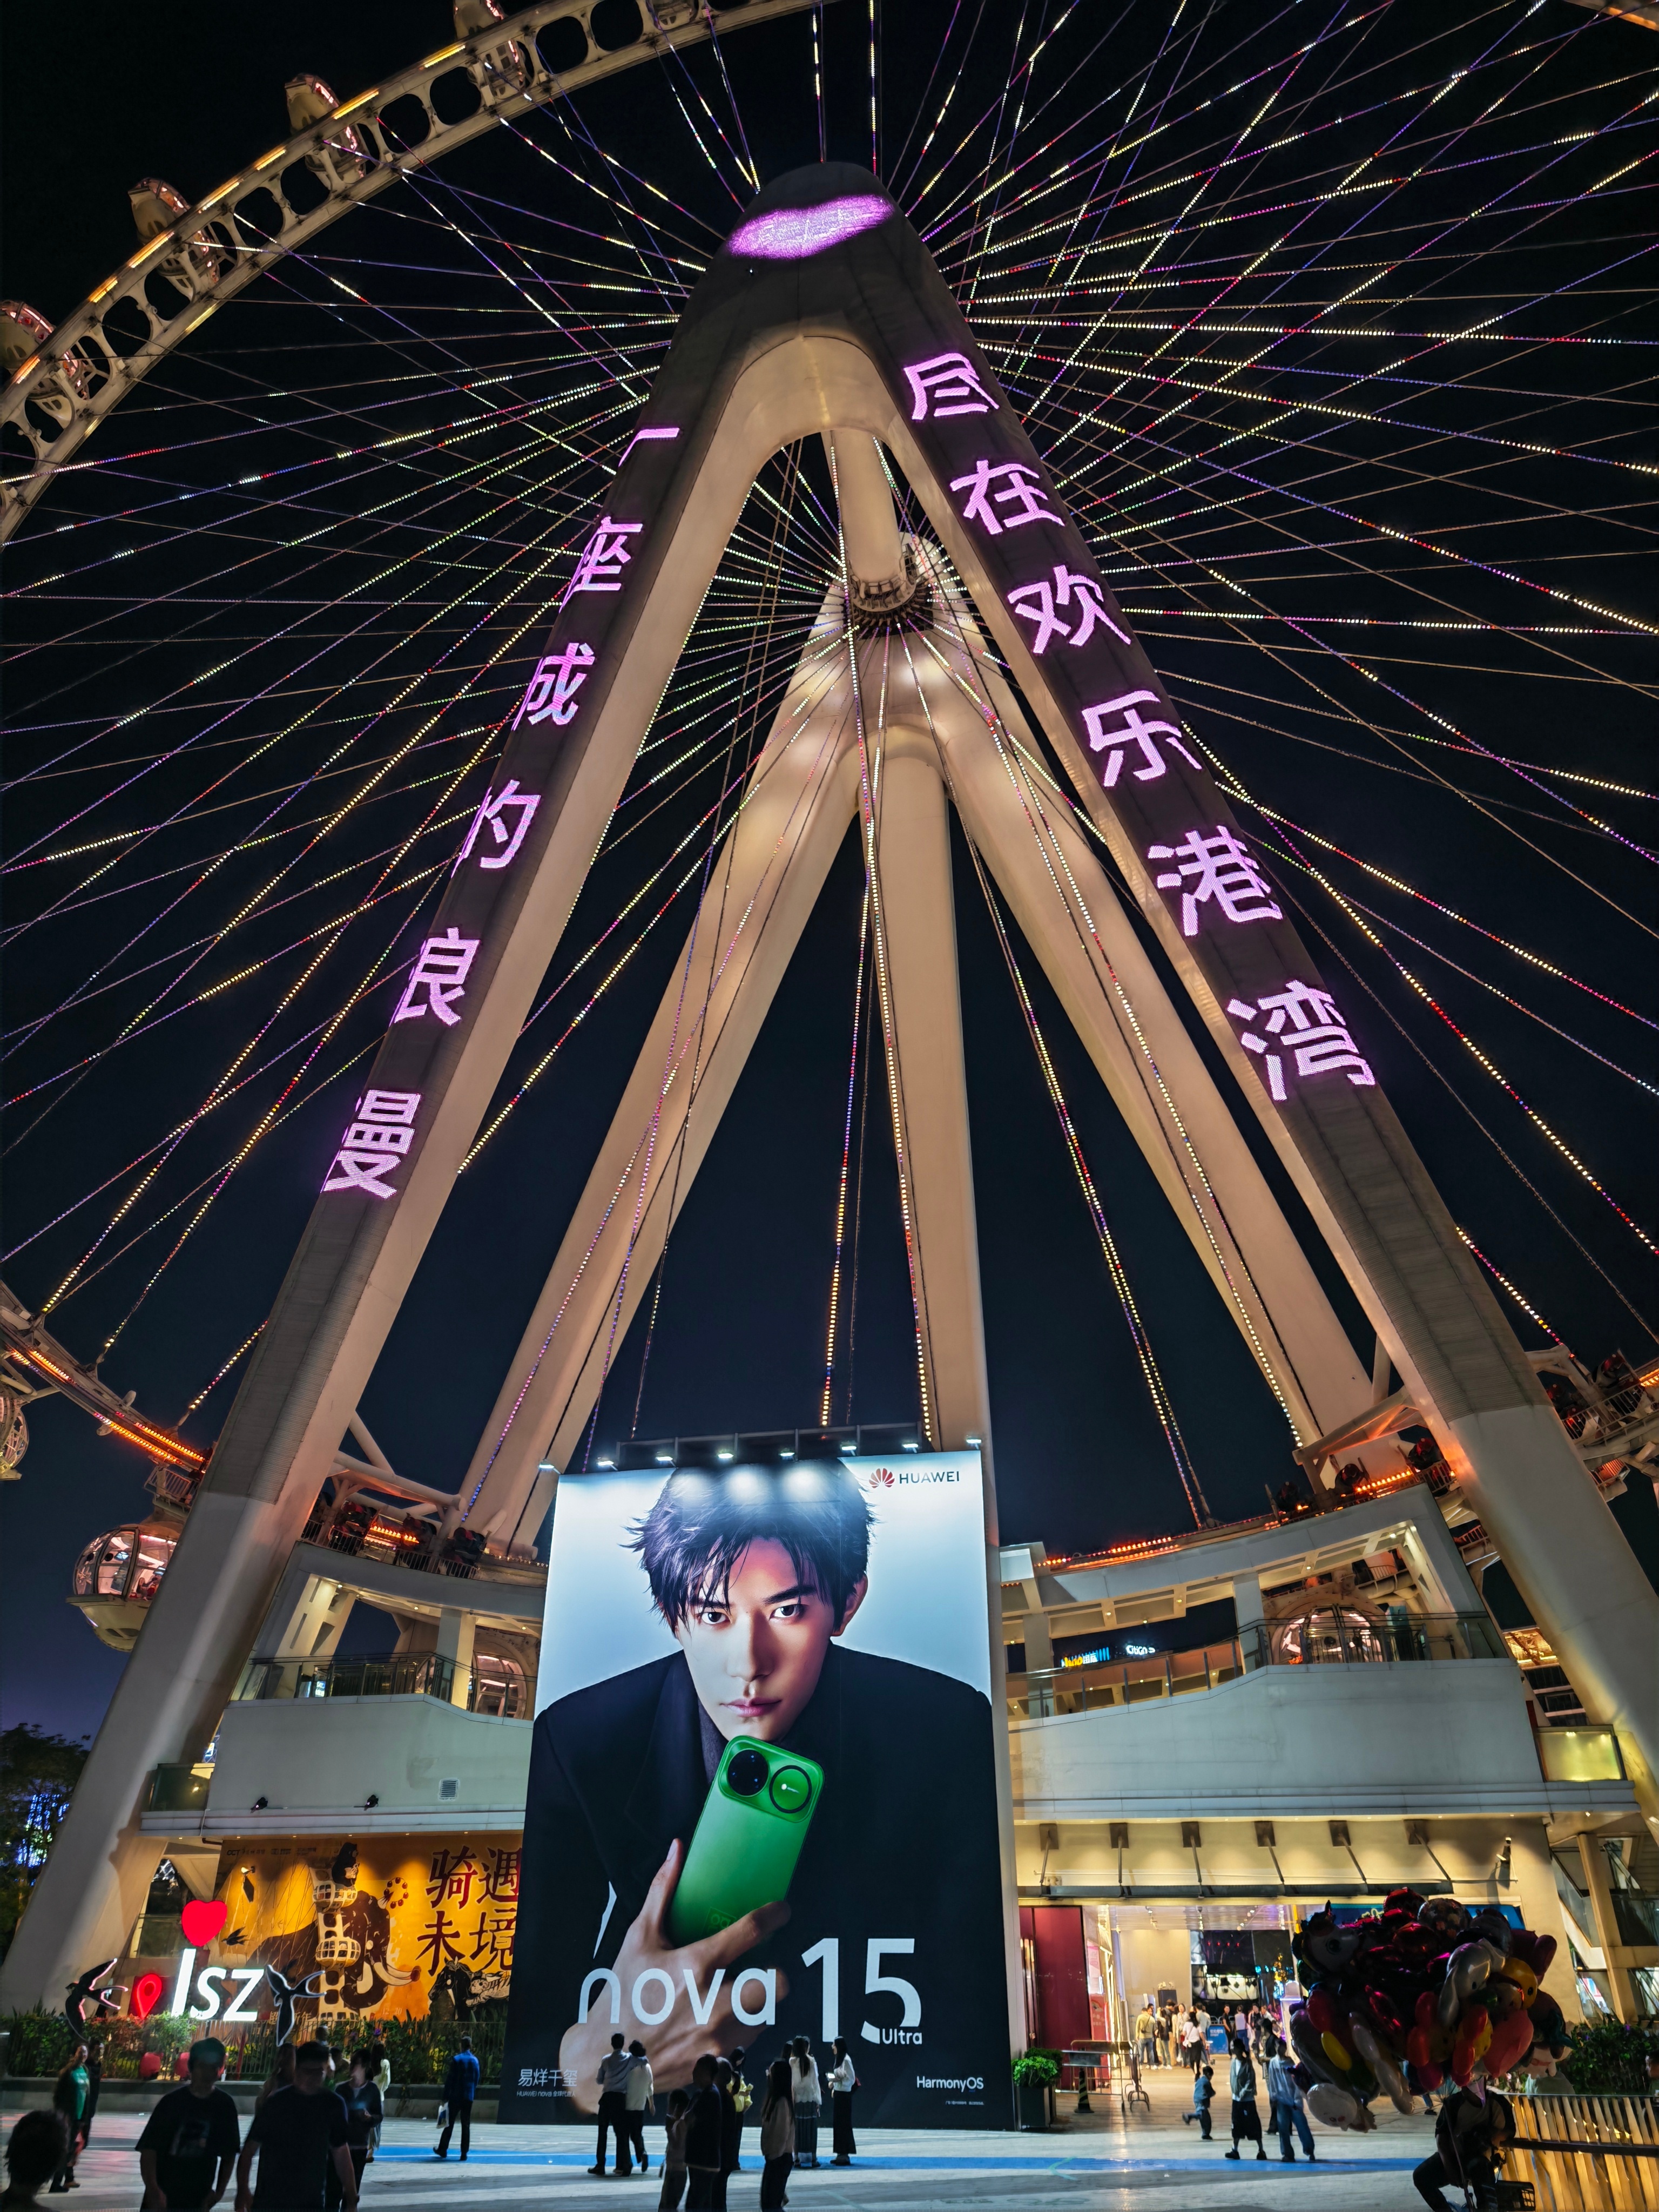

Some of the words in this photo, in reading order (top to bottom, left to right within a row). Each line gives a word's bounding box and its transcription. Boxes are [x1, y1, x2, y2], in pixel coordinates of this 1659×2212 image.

[903, 353, 1376, 1101] 尽在欢乐港湾
[899, 1471, 960, 1484] HUAWEI
[426, 1845, 522, 1910] 骑遇
[416, 1911, 517, 1977] 未境
[578, 1966, 777, 2026] nova
[801, 1938, 922, 2044] 15
[882, 2028, 922, 2045] Ultra
[517, 2068, 578, 2087] 易烊千玺
[916, 2075, 984, 2093] HarmonyOS
